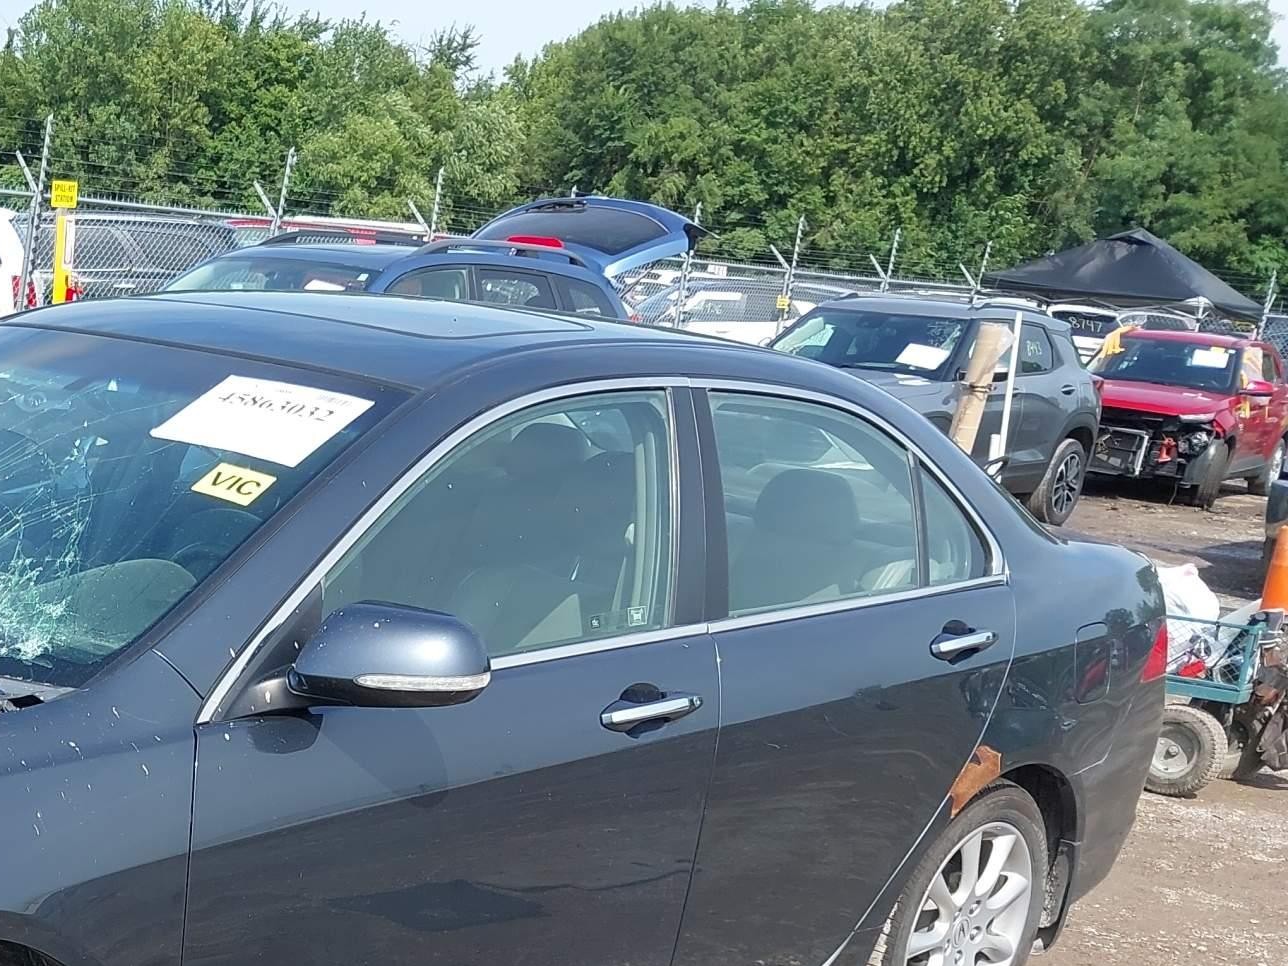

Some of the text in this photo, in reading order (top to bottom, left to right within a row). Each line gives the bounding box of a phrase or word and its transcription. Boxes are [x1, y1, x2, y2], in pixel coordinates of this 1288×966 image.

[1069, 316, 1102, 332] 8747
[218, 392, 334, 421] 45863032
[211, 472, 261, 495] VIC
